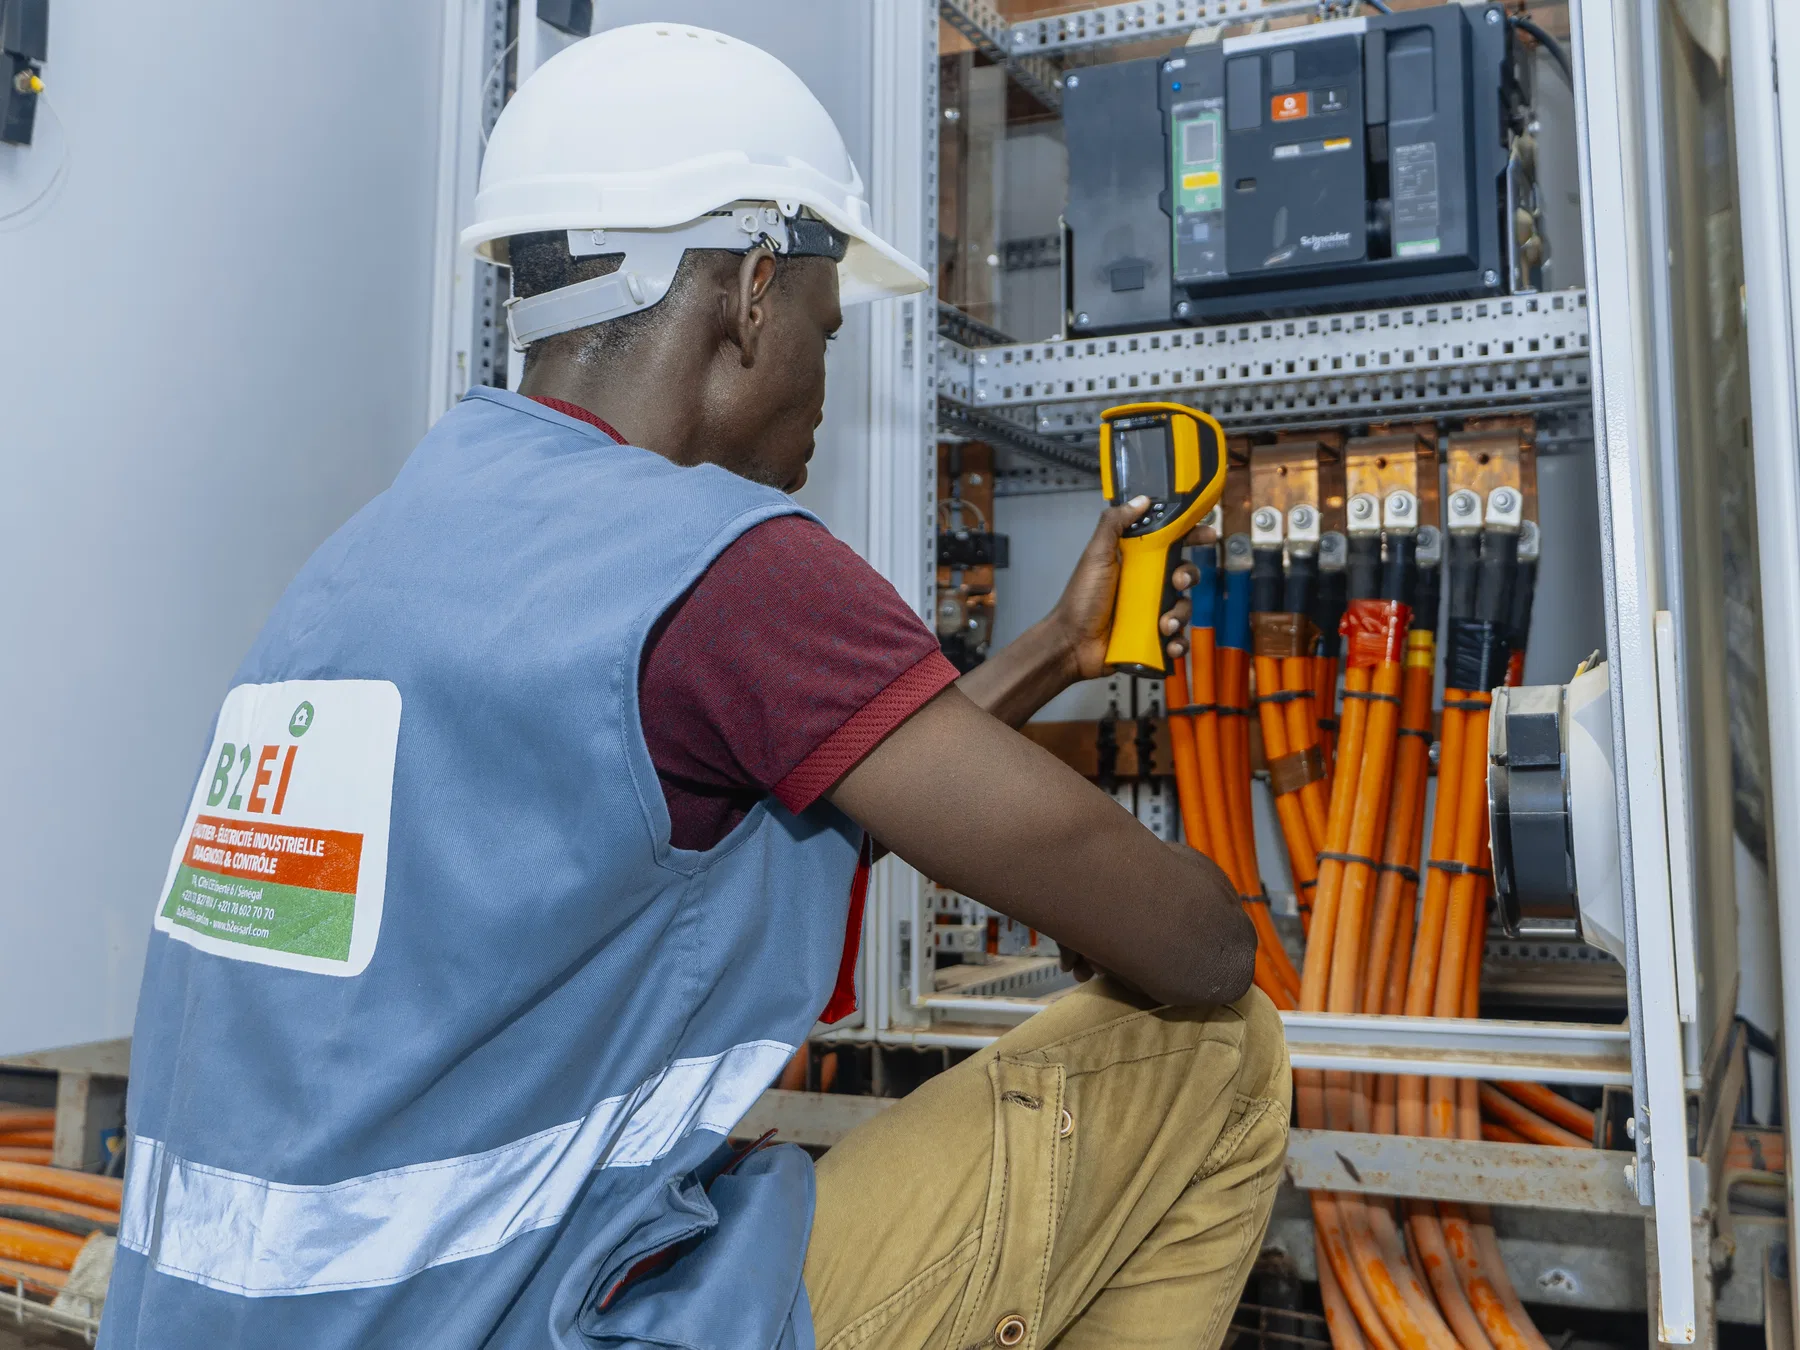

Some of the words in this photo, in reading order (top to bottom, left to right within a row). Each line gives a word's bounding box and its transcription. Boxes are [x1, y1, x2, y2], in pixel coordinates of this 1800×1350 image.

[1300, 231, 1351, 245] Schneider
[206, 742, 298, 815] B2EI
[252, 832, 325, 857] INDUSTRIELLE
[192, 844, 225, 866] DIAGNOS
[224, 850, 232, 868] &
[232, 852, 279, 875] CONTRÔLE
[237, 884, 264, 902] Sénégal
[217, 900, 230, 914] +221
[239, 903, 252, 917] 602
[252, 906, 262, 920] 70
[263, 907, 275, 921] 70
[213, 919, 270, 939] www.b2ei-sarl.com
